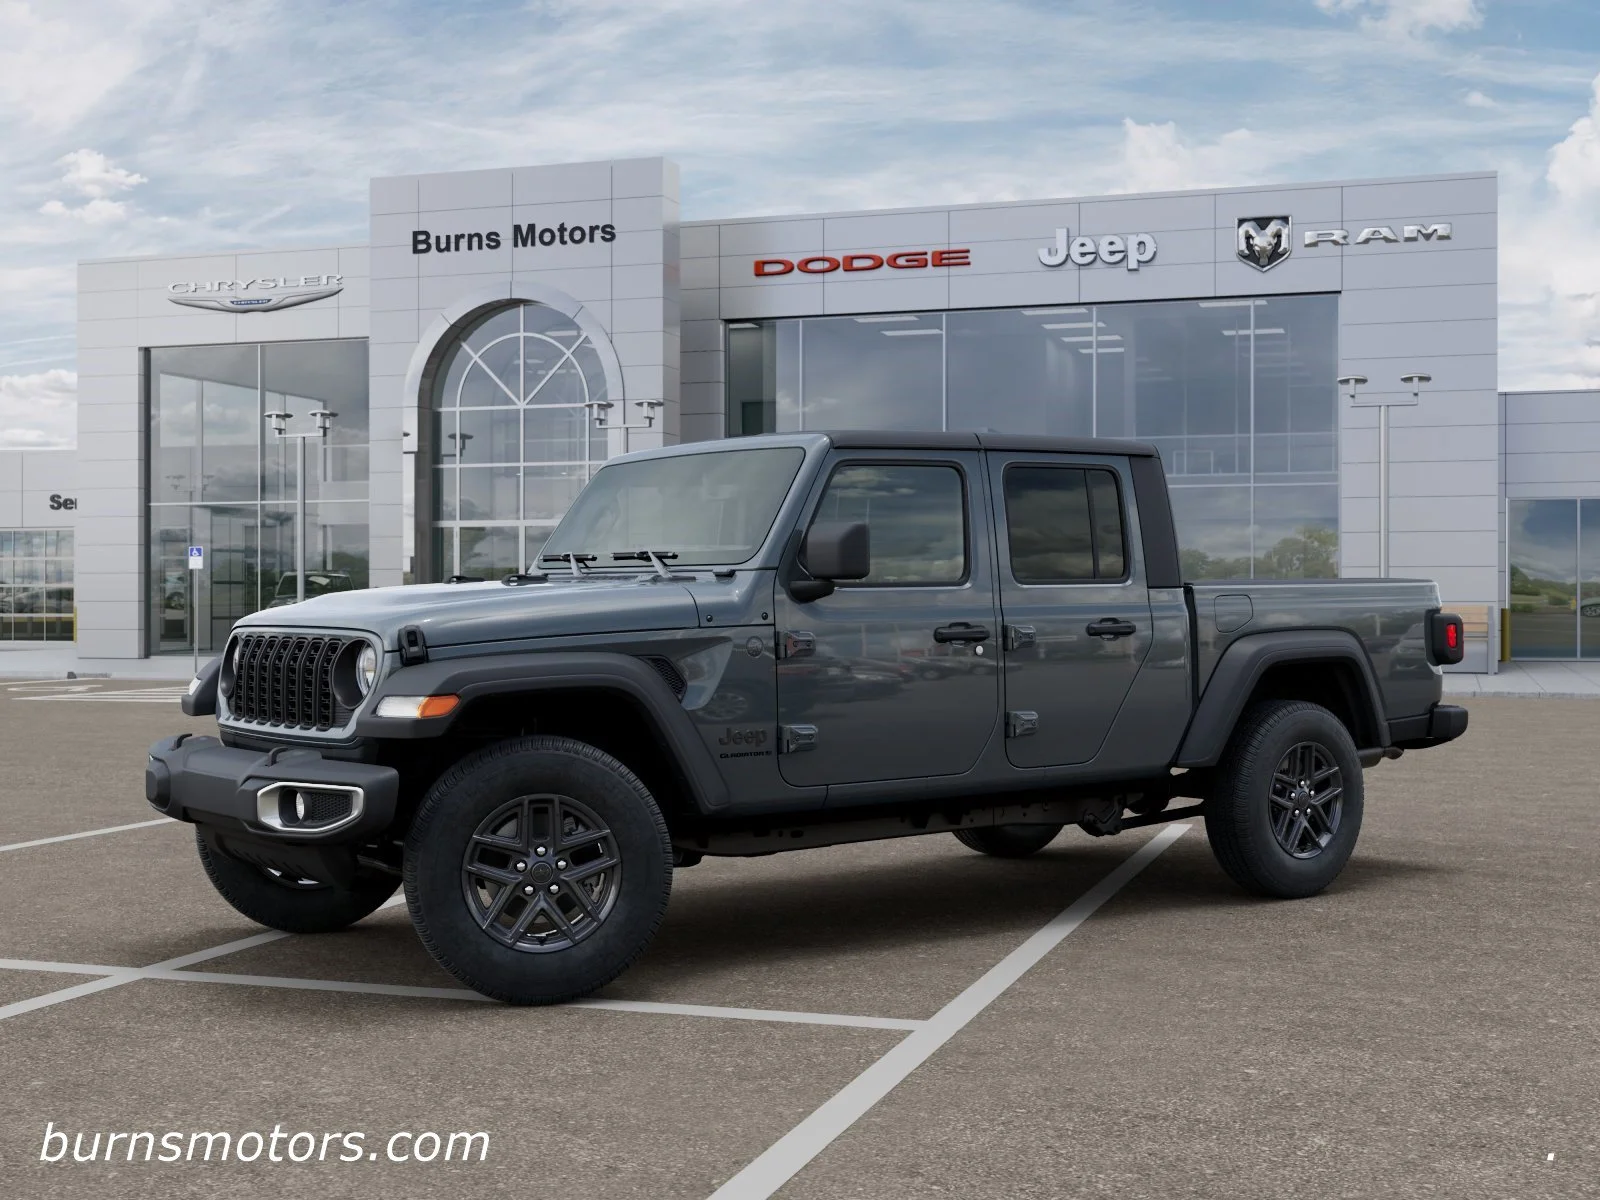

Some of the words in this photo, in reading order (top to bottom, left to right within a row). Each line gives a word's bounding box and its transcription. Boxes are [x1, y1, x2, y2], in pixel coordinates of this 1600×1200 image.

[412, 230, 501, 254] Burns
[513, 222, 616, 248] Motors
[1304, 222, 1452, 246] RAM
[1038, 227, 1158, 271] Jeep
[754, 249, 971, 277] DODGE
[168, 274, 343, 294] CHRYSLER
[718, 727, 767, 747] Jeep
